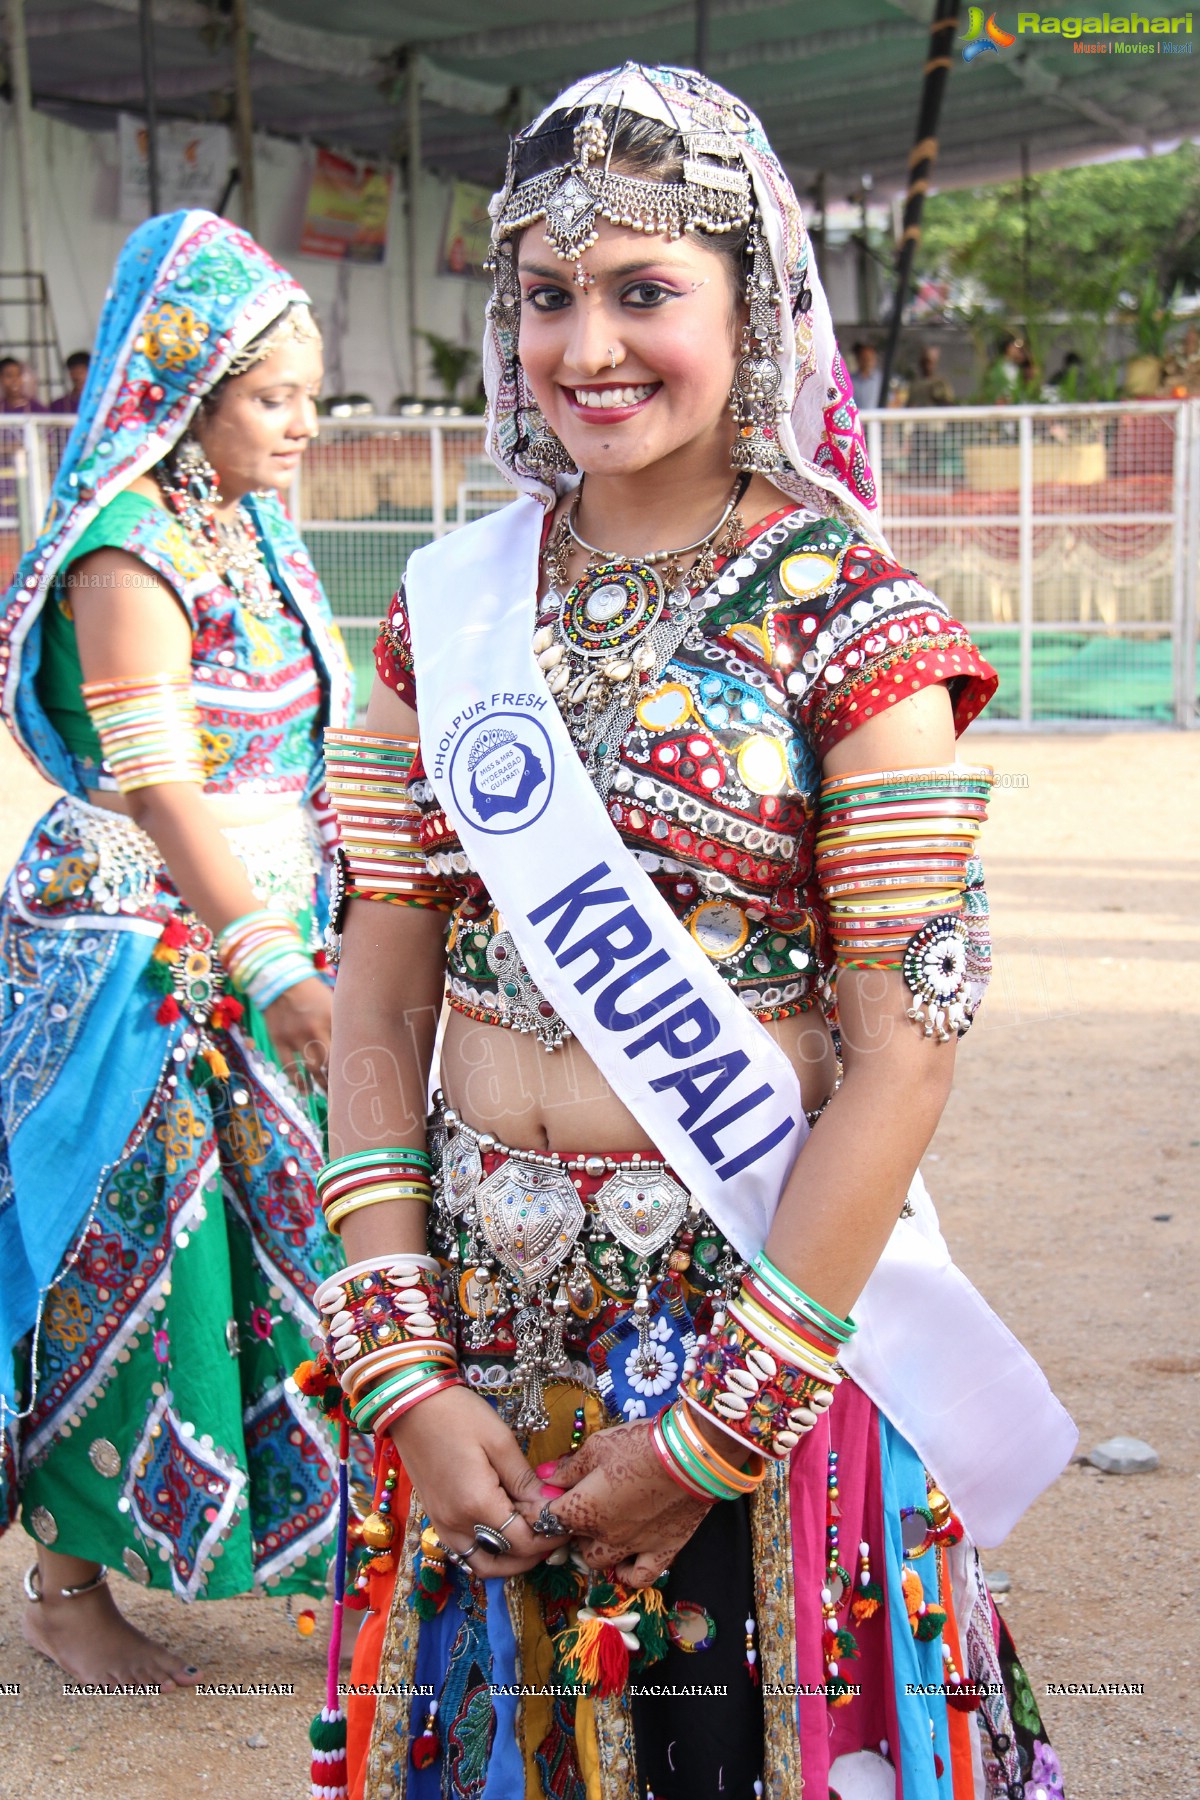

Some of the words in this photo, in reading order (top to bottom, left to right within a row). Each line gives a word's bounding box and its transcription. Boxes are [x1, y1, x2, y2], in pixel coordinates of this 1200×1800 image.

[434, 701, 487, 779] DHOLPUR
[491, 692, 548, 711] FRESH
[479, 762, 495, 777] MISS
[500, 749, 514, 763] MRS
[480, 755, 522, 787] HYDERABAD
[490, 768, 521, 791] GUJARATI
[526, 861, 795, 1182] KRUPALI
